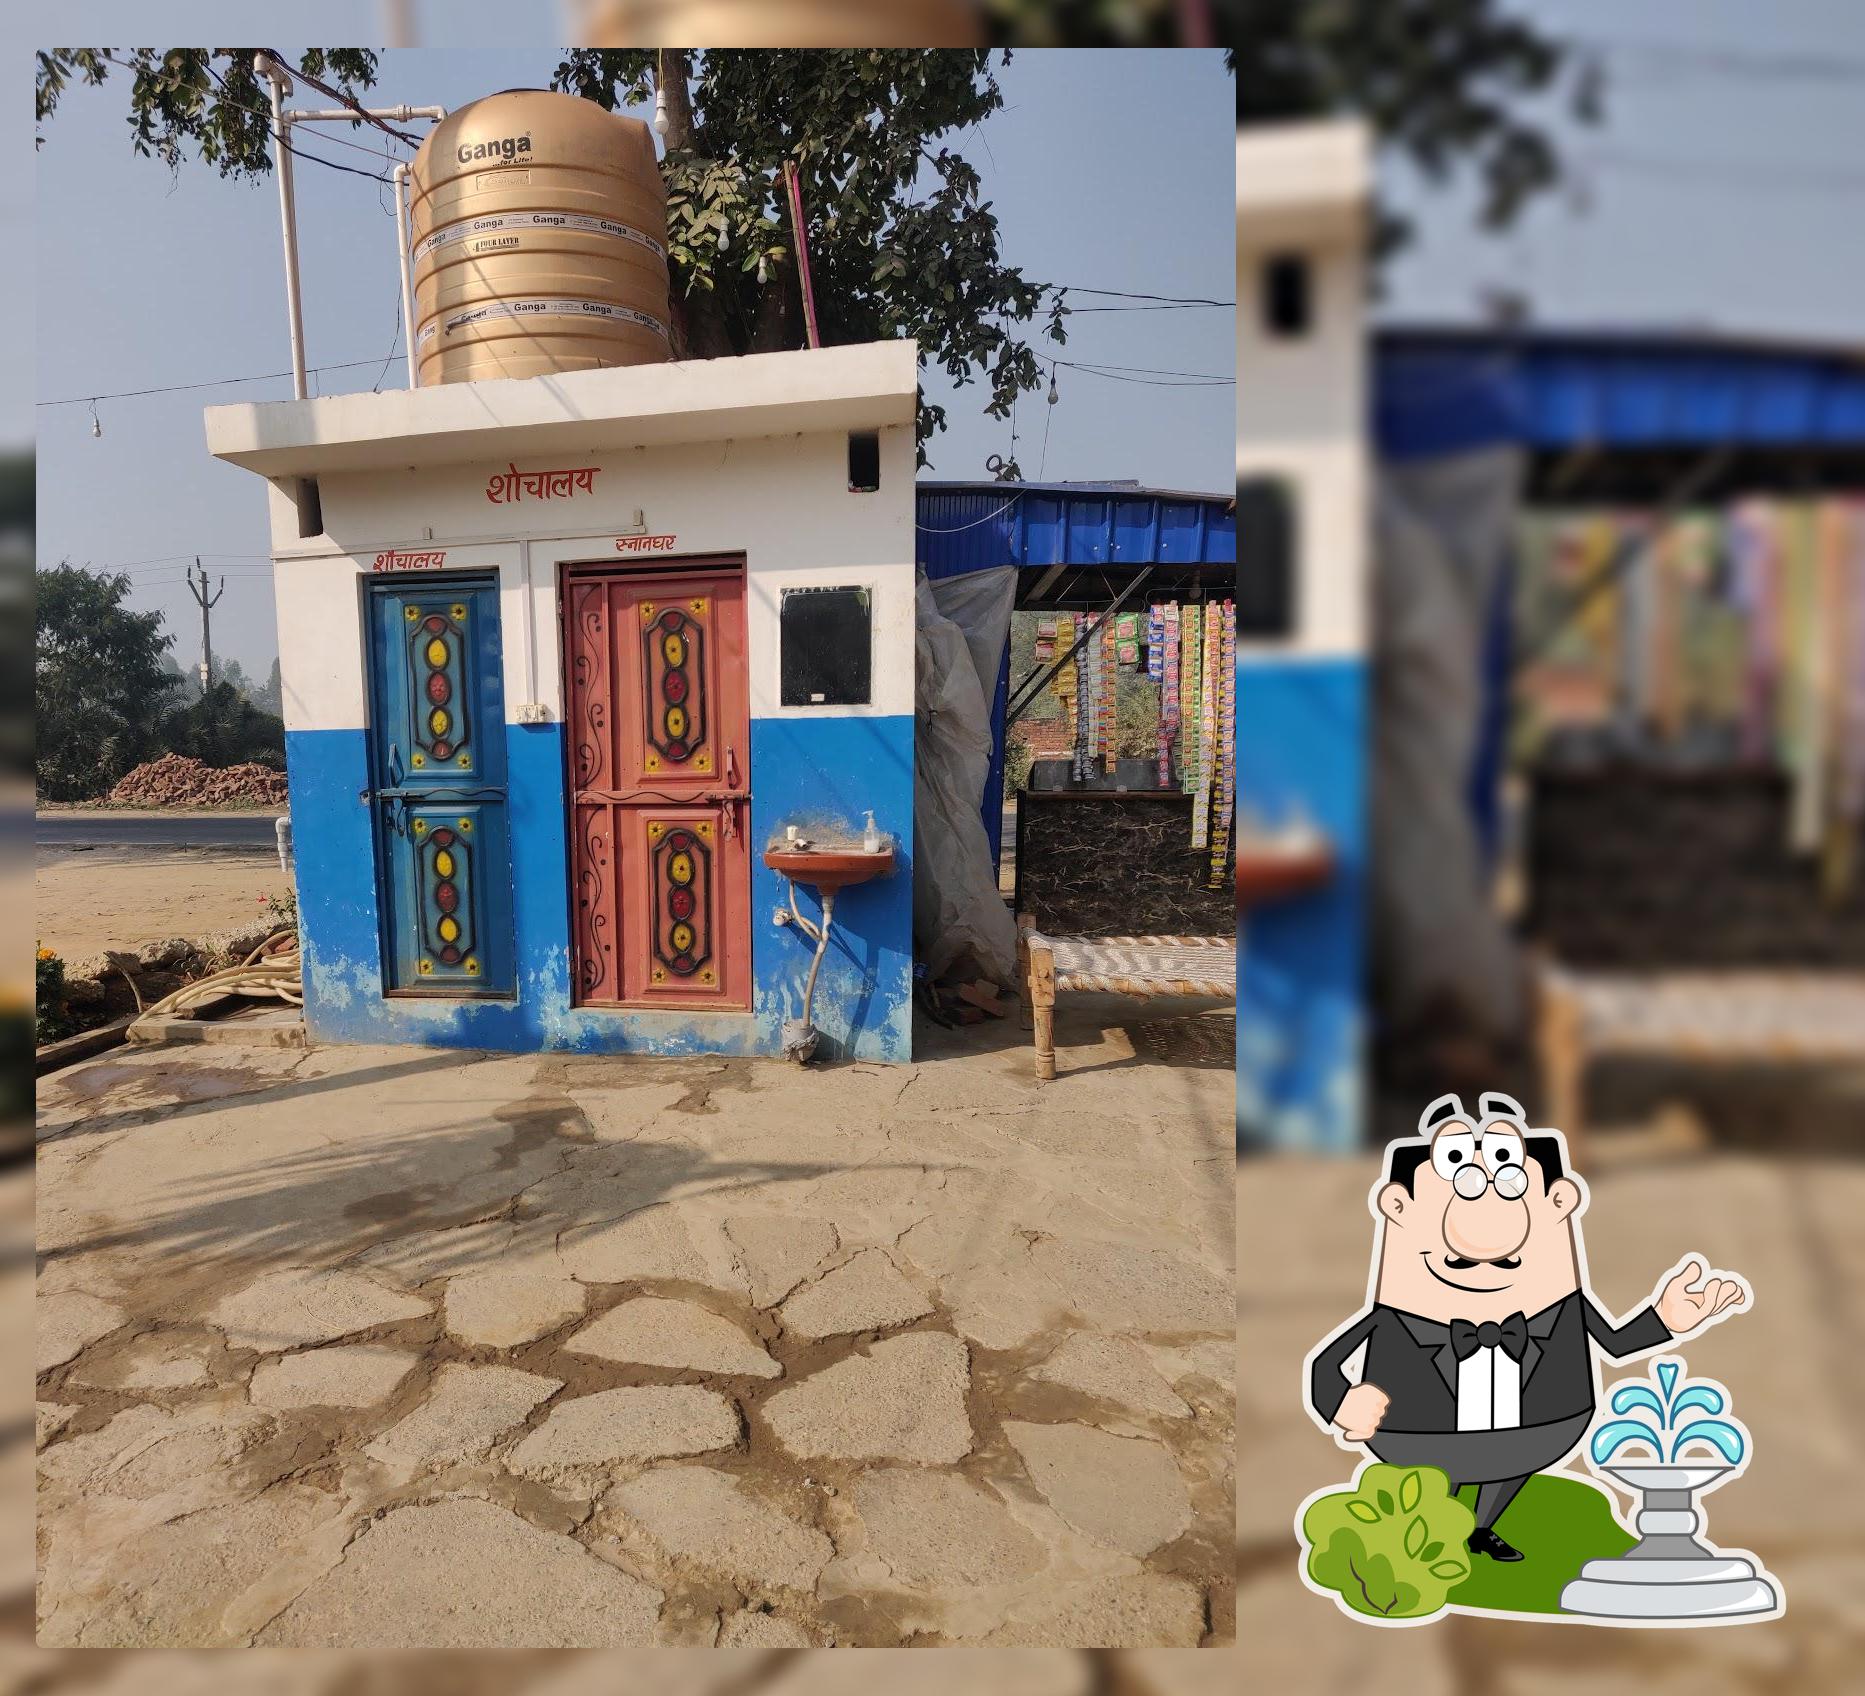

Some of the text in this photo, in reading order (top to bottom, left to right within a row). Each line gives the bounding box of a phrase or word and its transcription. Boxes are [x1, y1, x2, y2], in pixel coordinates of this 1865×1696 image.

[457, 136, 532, 164] Ganga
[426, 233, 447, 248] Ganga
[473, 219, 504, 230] Ganga
[532, 215, 566, 226] Ganga
[600, 221, 628, 235] Ganga
[514, 302, 547, 312] Ganga
[582, 302, 612, 315] Ganga
[615, 535, 677, 552] स्नानघर
